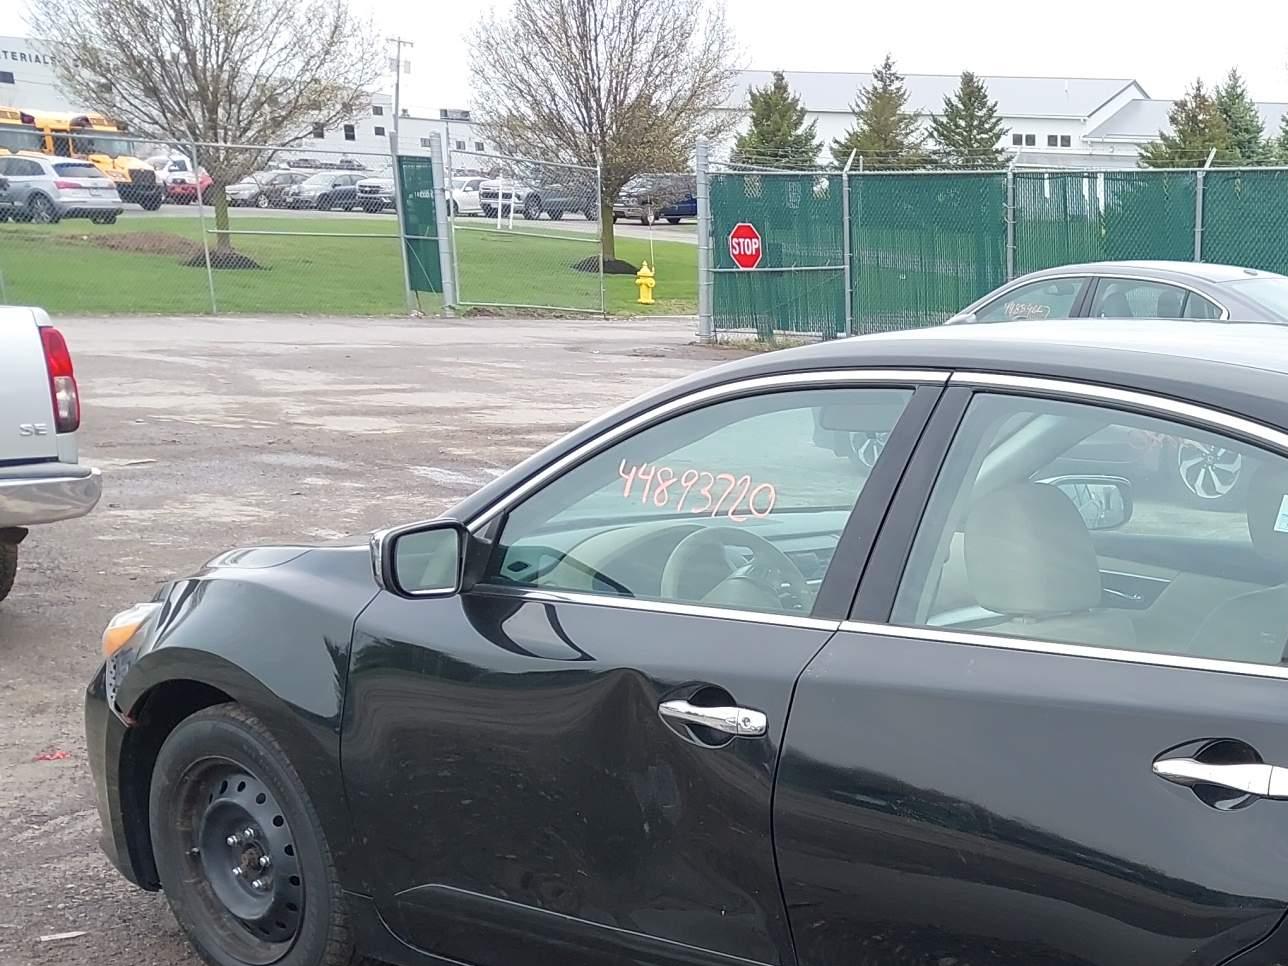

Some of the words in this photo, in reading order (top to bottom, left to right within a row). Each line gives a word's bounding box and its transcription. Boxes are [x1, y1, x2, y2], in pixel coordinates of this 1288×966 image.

[0, 50, 57, 65] TERIALS
[732, 238, 759, 255] STOP
[19, 423, 48, 436] SE
[618, 458, 776, 523] 44893720
